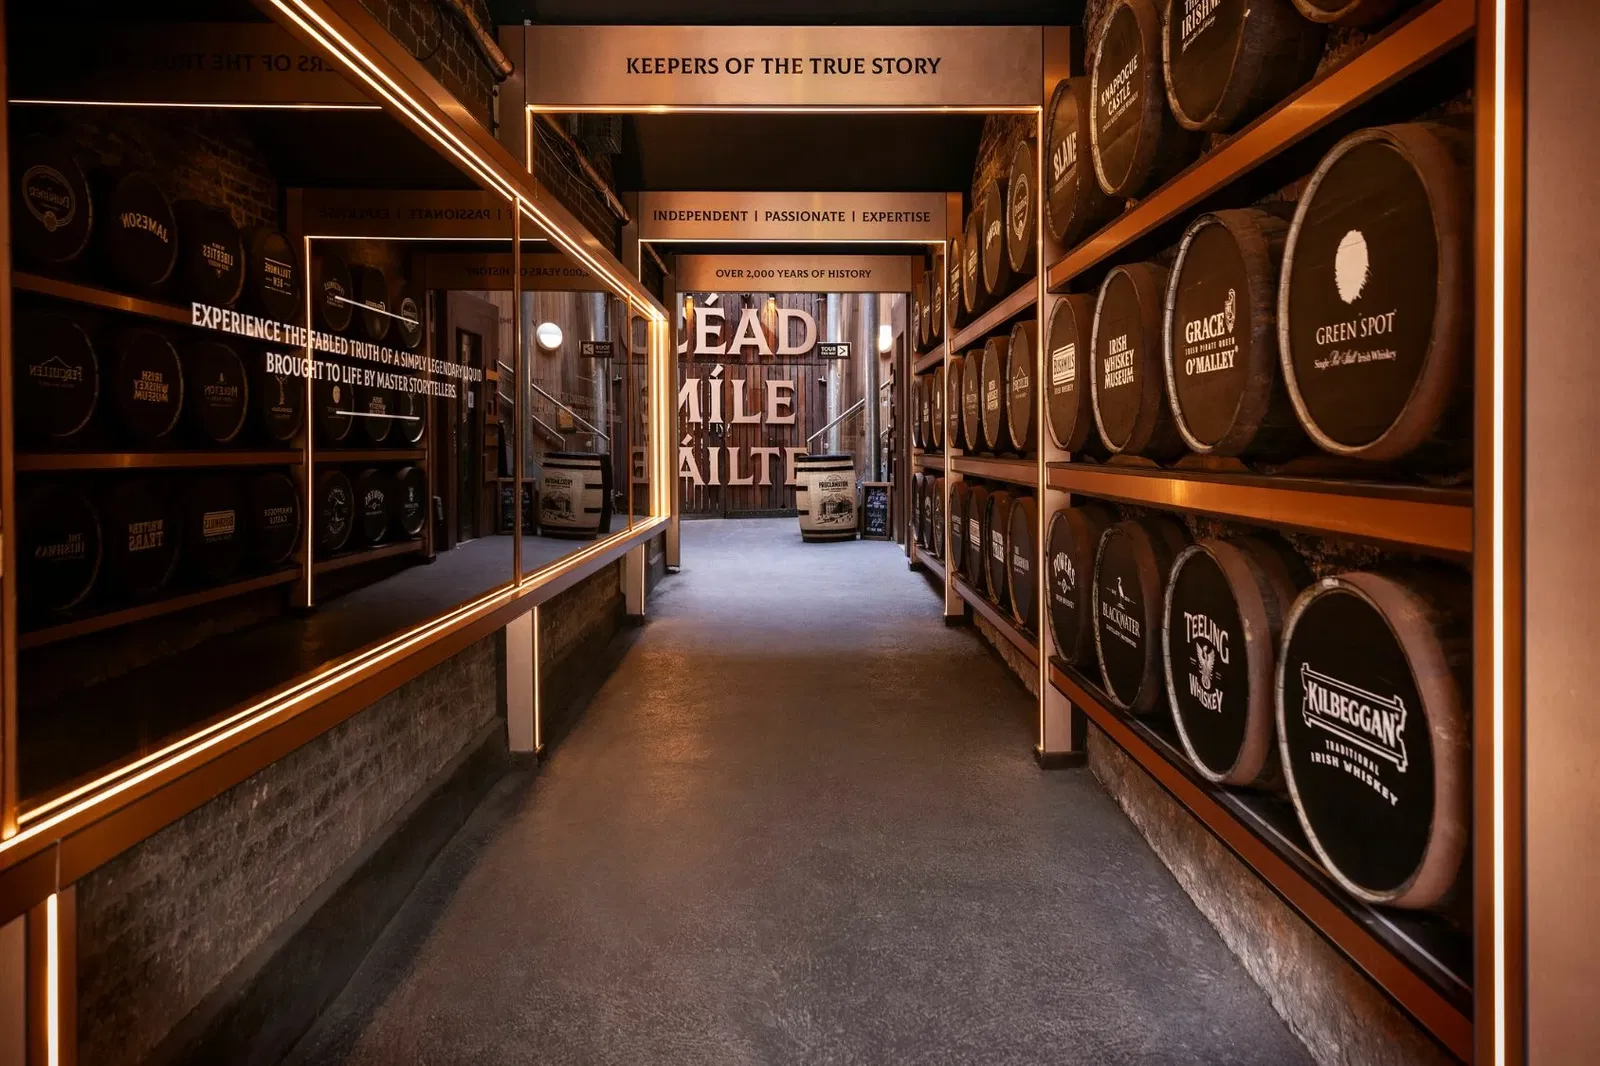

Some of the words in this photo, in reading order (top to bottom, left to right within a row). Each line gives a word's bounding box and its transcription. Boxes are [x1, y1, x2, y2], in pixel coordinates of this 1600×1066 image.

[626, 57, 719, 75] KEEPERS
[725, 57, 755, 75] OF
[761, 57, 804, 75] THE
[808, 57, 866, 75] TRUE
[872, 57, 942, 75] STORY
[1101, 54, 1138, 107] KNAPPOGUE
[1108, 81, 1131, 115] CASTLE
[1053, 131, 1077, 181] SLANE
[653, 210, 748, 222] INDEPENDENT
[765, 210, 846, 223] PASSIONATE
[862, 211, 931, 223] EXPERTISE
[715, 269, 744, 279] OVER
[746, 269, 775, 280] 2,000
[777, 269, 809, 279] YEARS
[812, 269, 826, 279] OF
[828, 269, 872, 279] HISTORY
[191, 302, 281, 342] EXPERIENCE
[284, 323, 307, 348] THE
[310, 329, 348, 356] FABLED
[350, 339, 380, 362] TRUTH
[381, 346, 393, 364] OF
[394, 350, 400, 367] A
[401, 351, 427, 371] SIMPLY
[427, 356, 463, 379] LEGENDARY
[463, 365, 482, 382] LIQUID
[1109, 334, 1127, 356] IRISH
[1185, 312, 1225, 344] GRACE
[1316, 320, 1357, 345] GREEN
[1360, 312, 1395, 338] SPOT
[266, 352, 324, 380] BROUGHT
[325, 362, 339, 382] TO
[342, 366, 362, 385] LIFE
[364, 370, 376, 387] BY
[377, 372, 409, 392] MASTER
[1104, 348, 1134, 375] WHISKEY
[1314, 357, 1330, 370] Single
[1357, 350, 1371, 363] Irish
[1371, 348, 1397, 361] Whiskey
[1104, 366, 1134, 390] MUSEUM
[1053, 552, 1075, 586] POWERS
[1102, 601, 1140, 638] BLACKWATER
[1184, 611, 1229, 665] TEELING
[1189, 672, 1223, 713] WHISKEY
[1308, 680, 1398, 748] KILBEGGAN
[1325, 739, 1380, 777] TRADITIONAL
[1310, 751, 1340, 768] IRISH
[1342, 760, 1399, 806] WHISKEY
